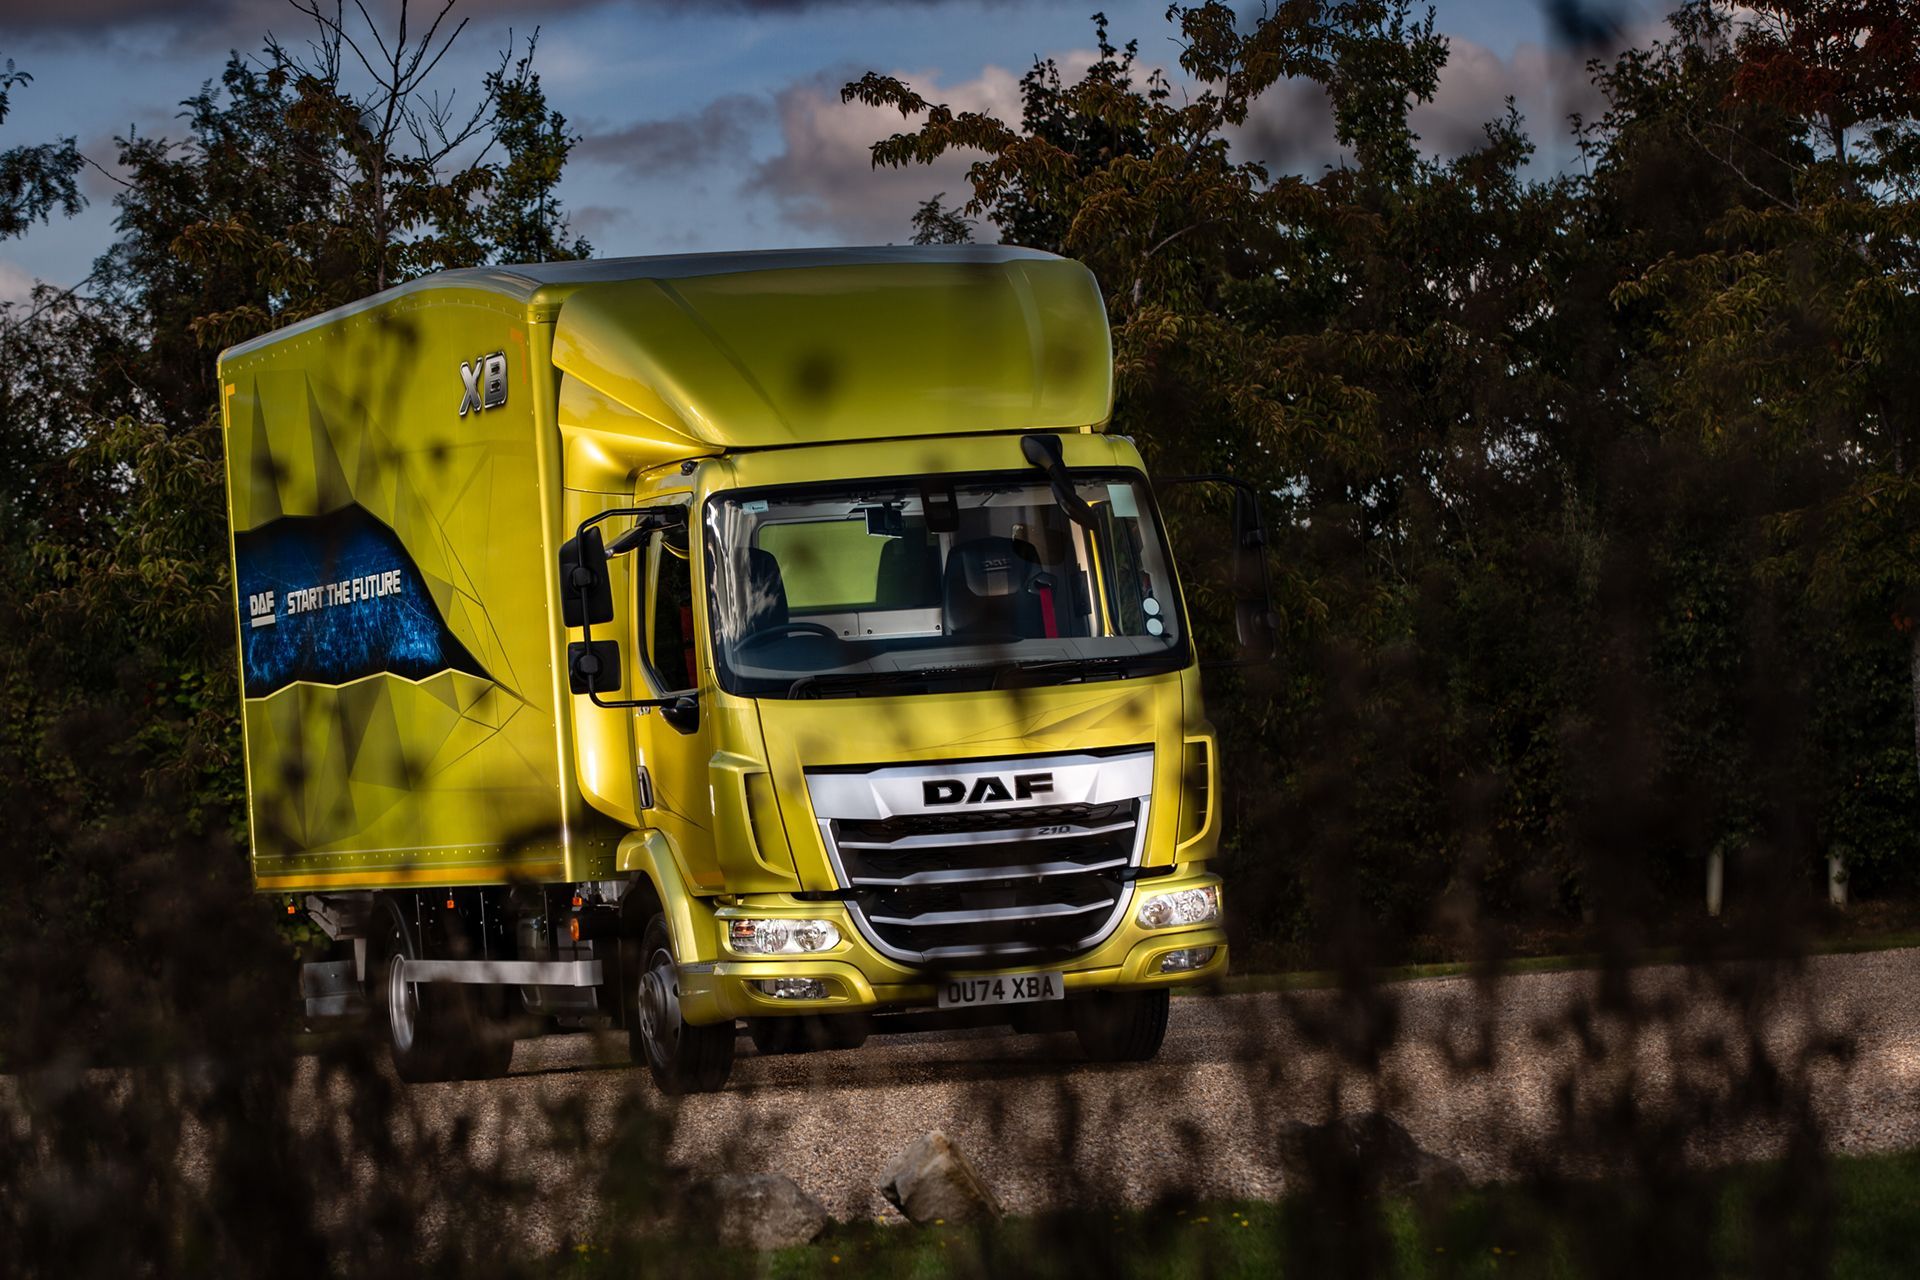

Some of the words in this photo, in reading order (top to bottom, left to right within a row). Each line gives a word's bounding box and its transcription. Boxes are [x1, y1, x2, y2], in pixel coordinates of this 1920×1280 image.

[458, 351, 507, 417] XB
[250, 591, 275, 616] DAF
[287, 585, 324, 615] START
[327, 580, 350, 607] THE
[352, 569, 402, 602] FUTURE
[922, 772, 1054, 807] DAF
[1037, 825, 1072, 835] 210
[947, 979, 1005, 1004] OU74
[1011, 975, 1055, 999] XBA
